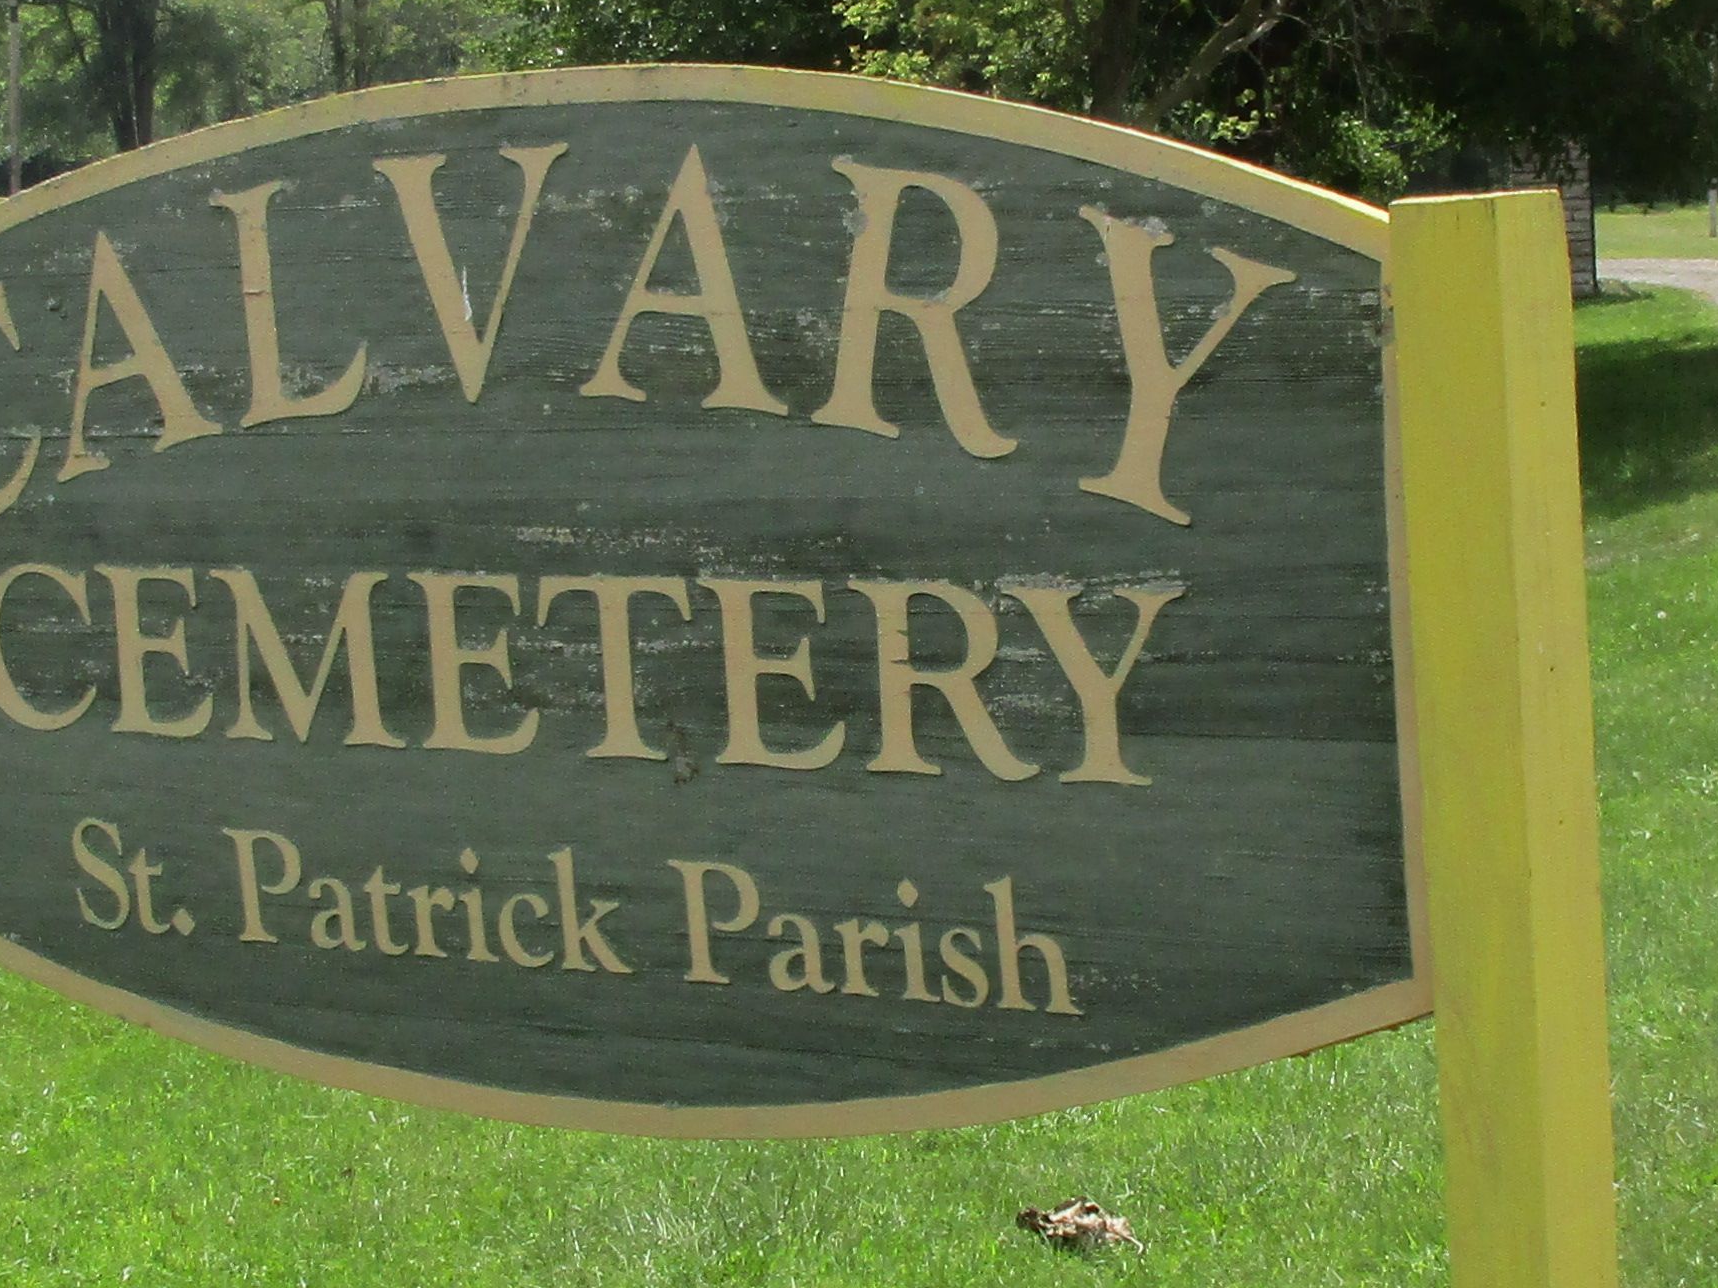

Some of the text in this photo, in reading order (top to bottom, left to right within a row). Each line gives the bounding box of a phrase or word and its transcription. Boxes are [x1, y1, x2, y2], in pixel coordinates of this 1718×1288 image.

[70, 817, 1083, 1017] St. Patrick Parish
